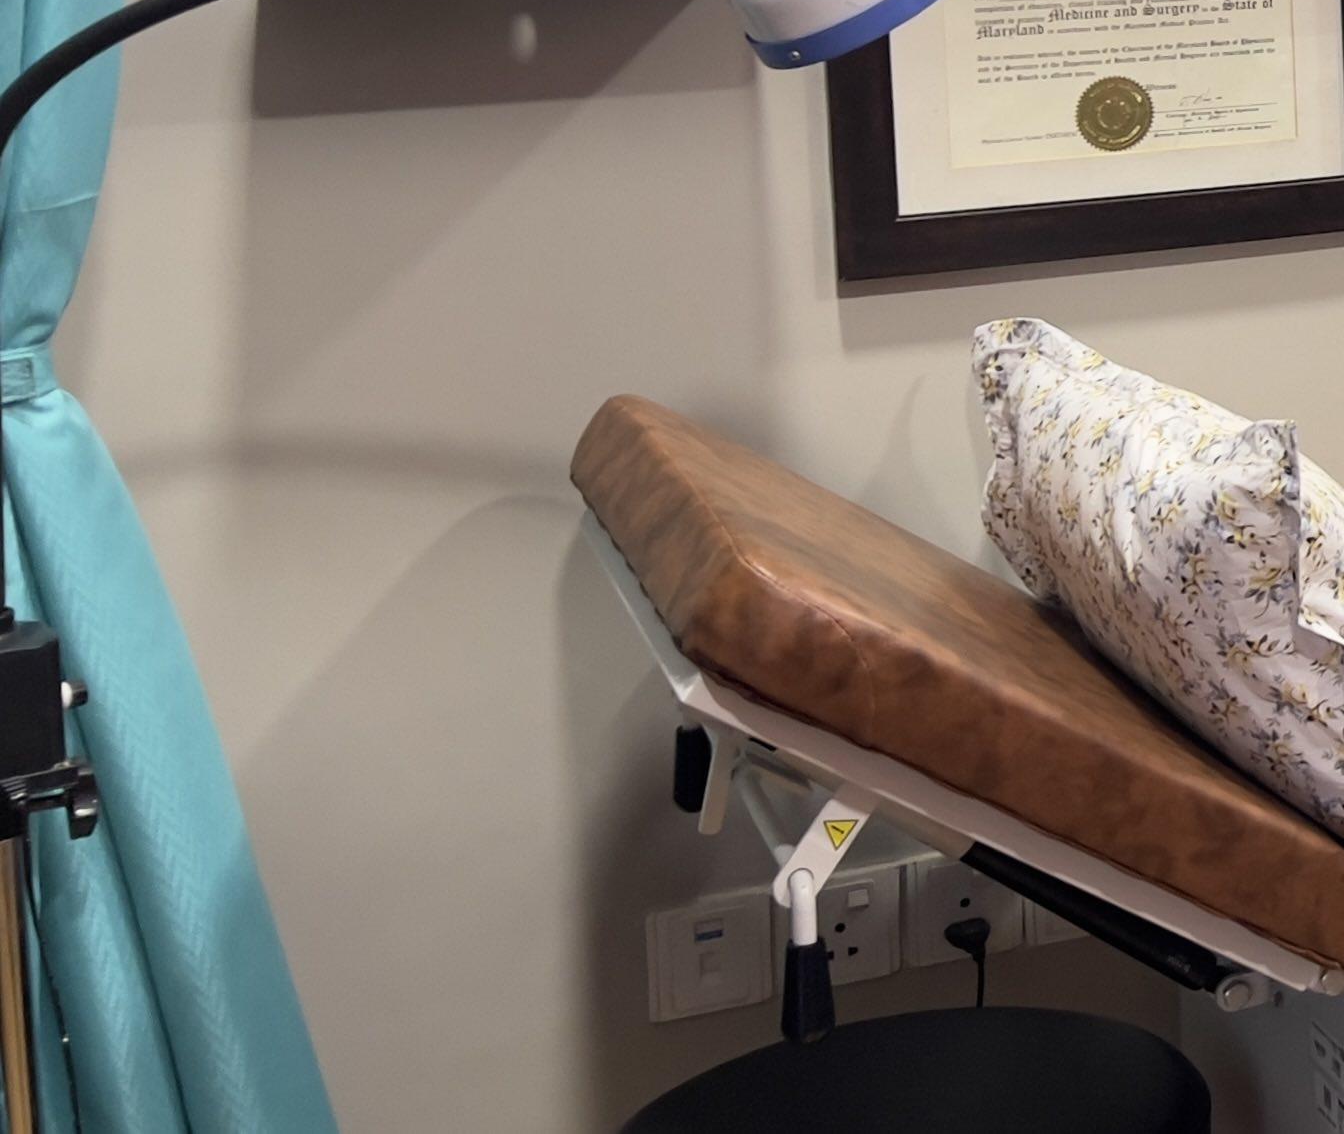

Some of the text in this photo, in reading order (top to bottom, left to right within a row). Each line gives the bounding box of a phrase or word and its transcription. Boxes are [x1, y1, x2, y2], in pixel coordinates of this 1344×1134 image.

[1047, 6, 1111, 23] Medicine
[1114, 4, 1138, 18] and
[1142, 2, 1201, 19] Surgery
[975, 24, 1045, 41] Maryland
